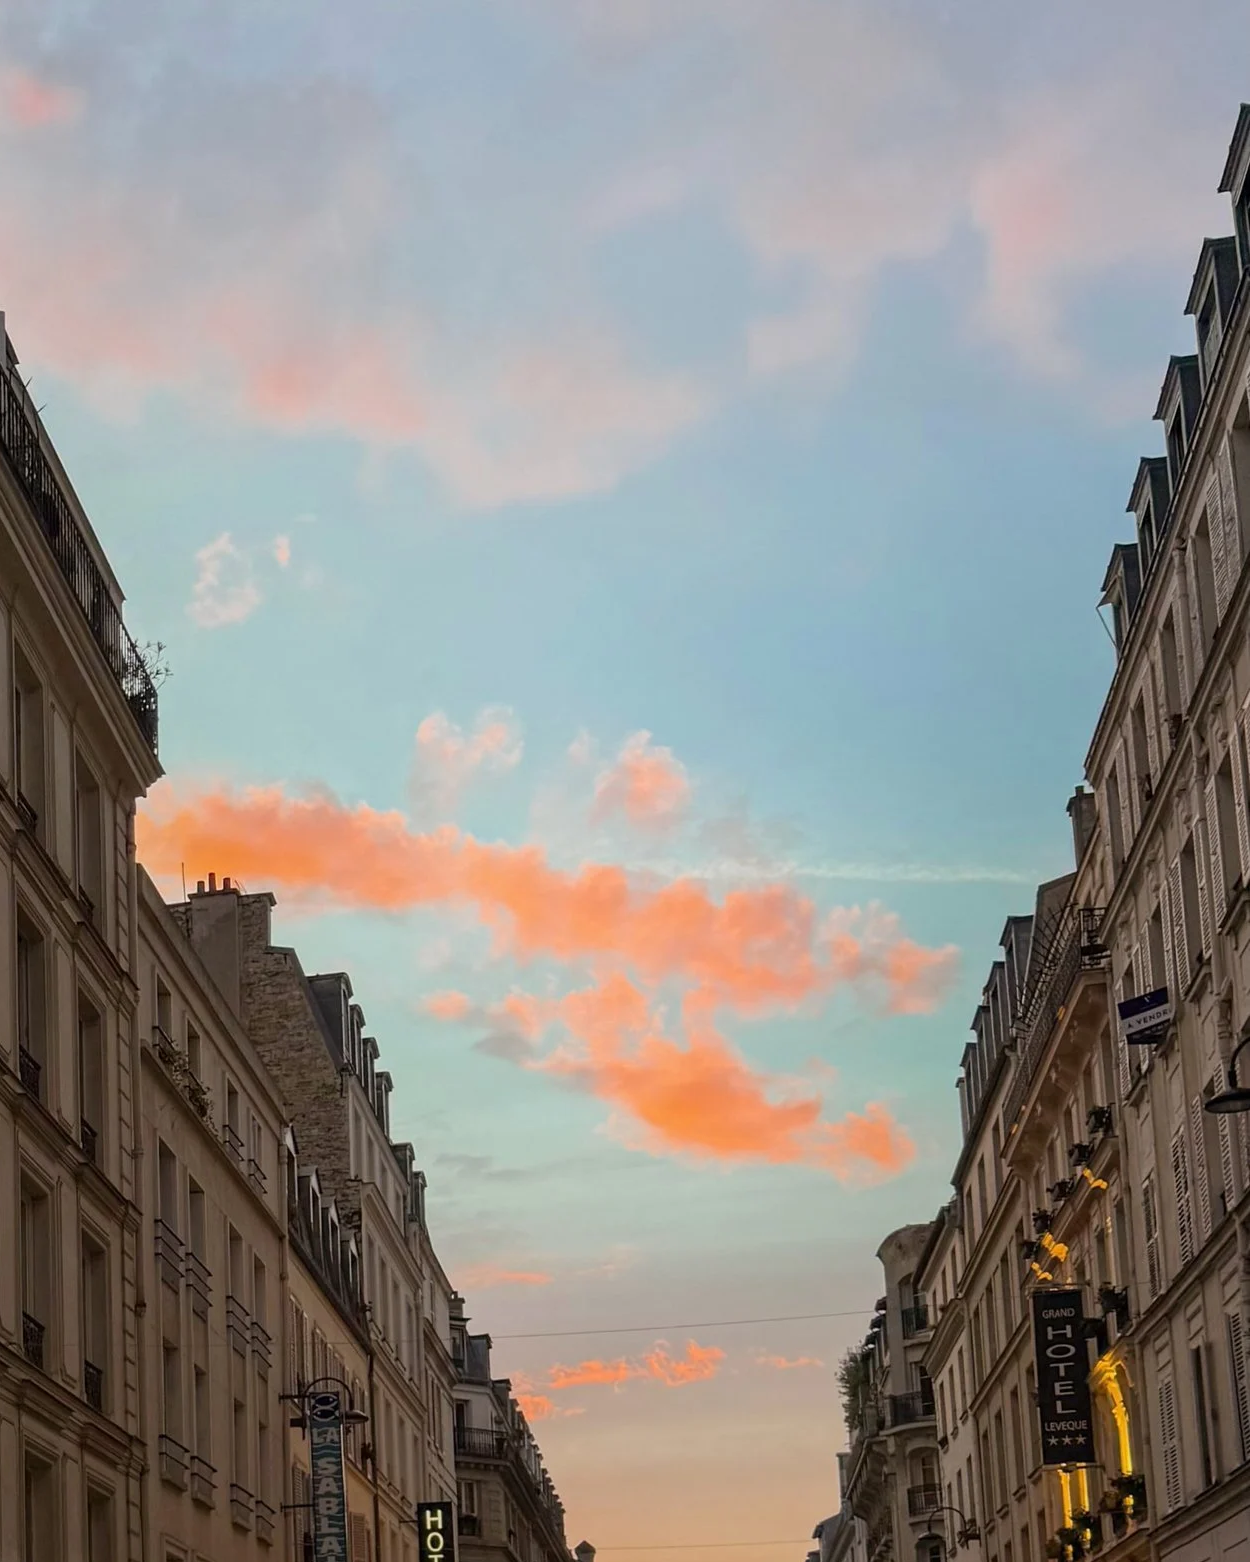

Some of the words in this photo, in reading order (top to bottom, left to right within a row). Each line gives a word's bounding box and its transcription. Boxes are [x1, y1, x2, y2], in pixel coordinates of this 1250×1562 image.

[1042, 1308, 1075, 1319] GRAND
[1045, 1325, 1077, 1414] HOTEL
[1045, 1420, 1088, 1432] LEVEQUE
[312, 1426, 339, 1443] LA
